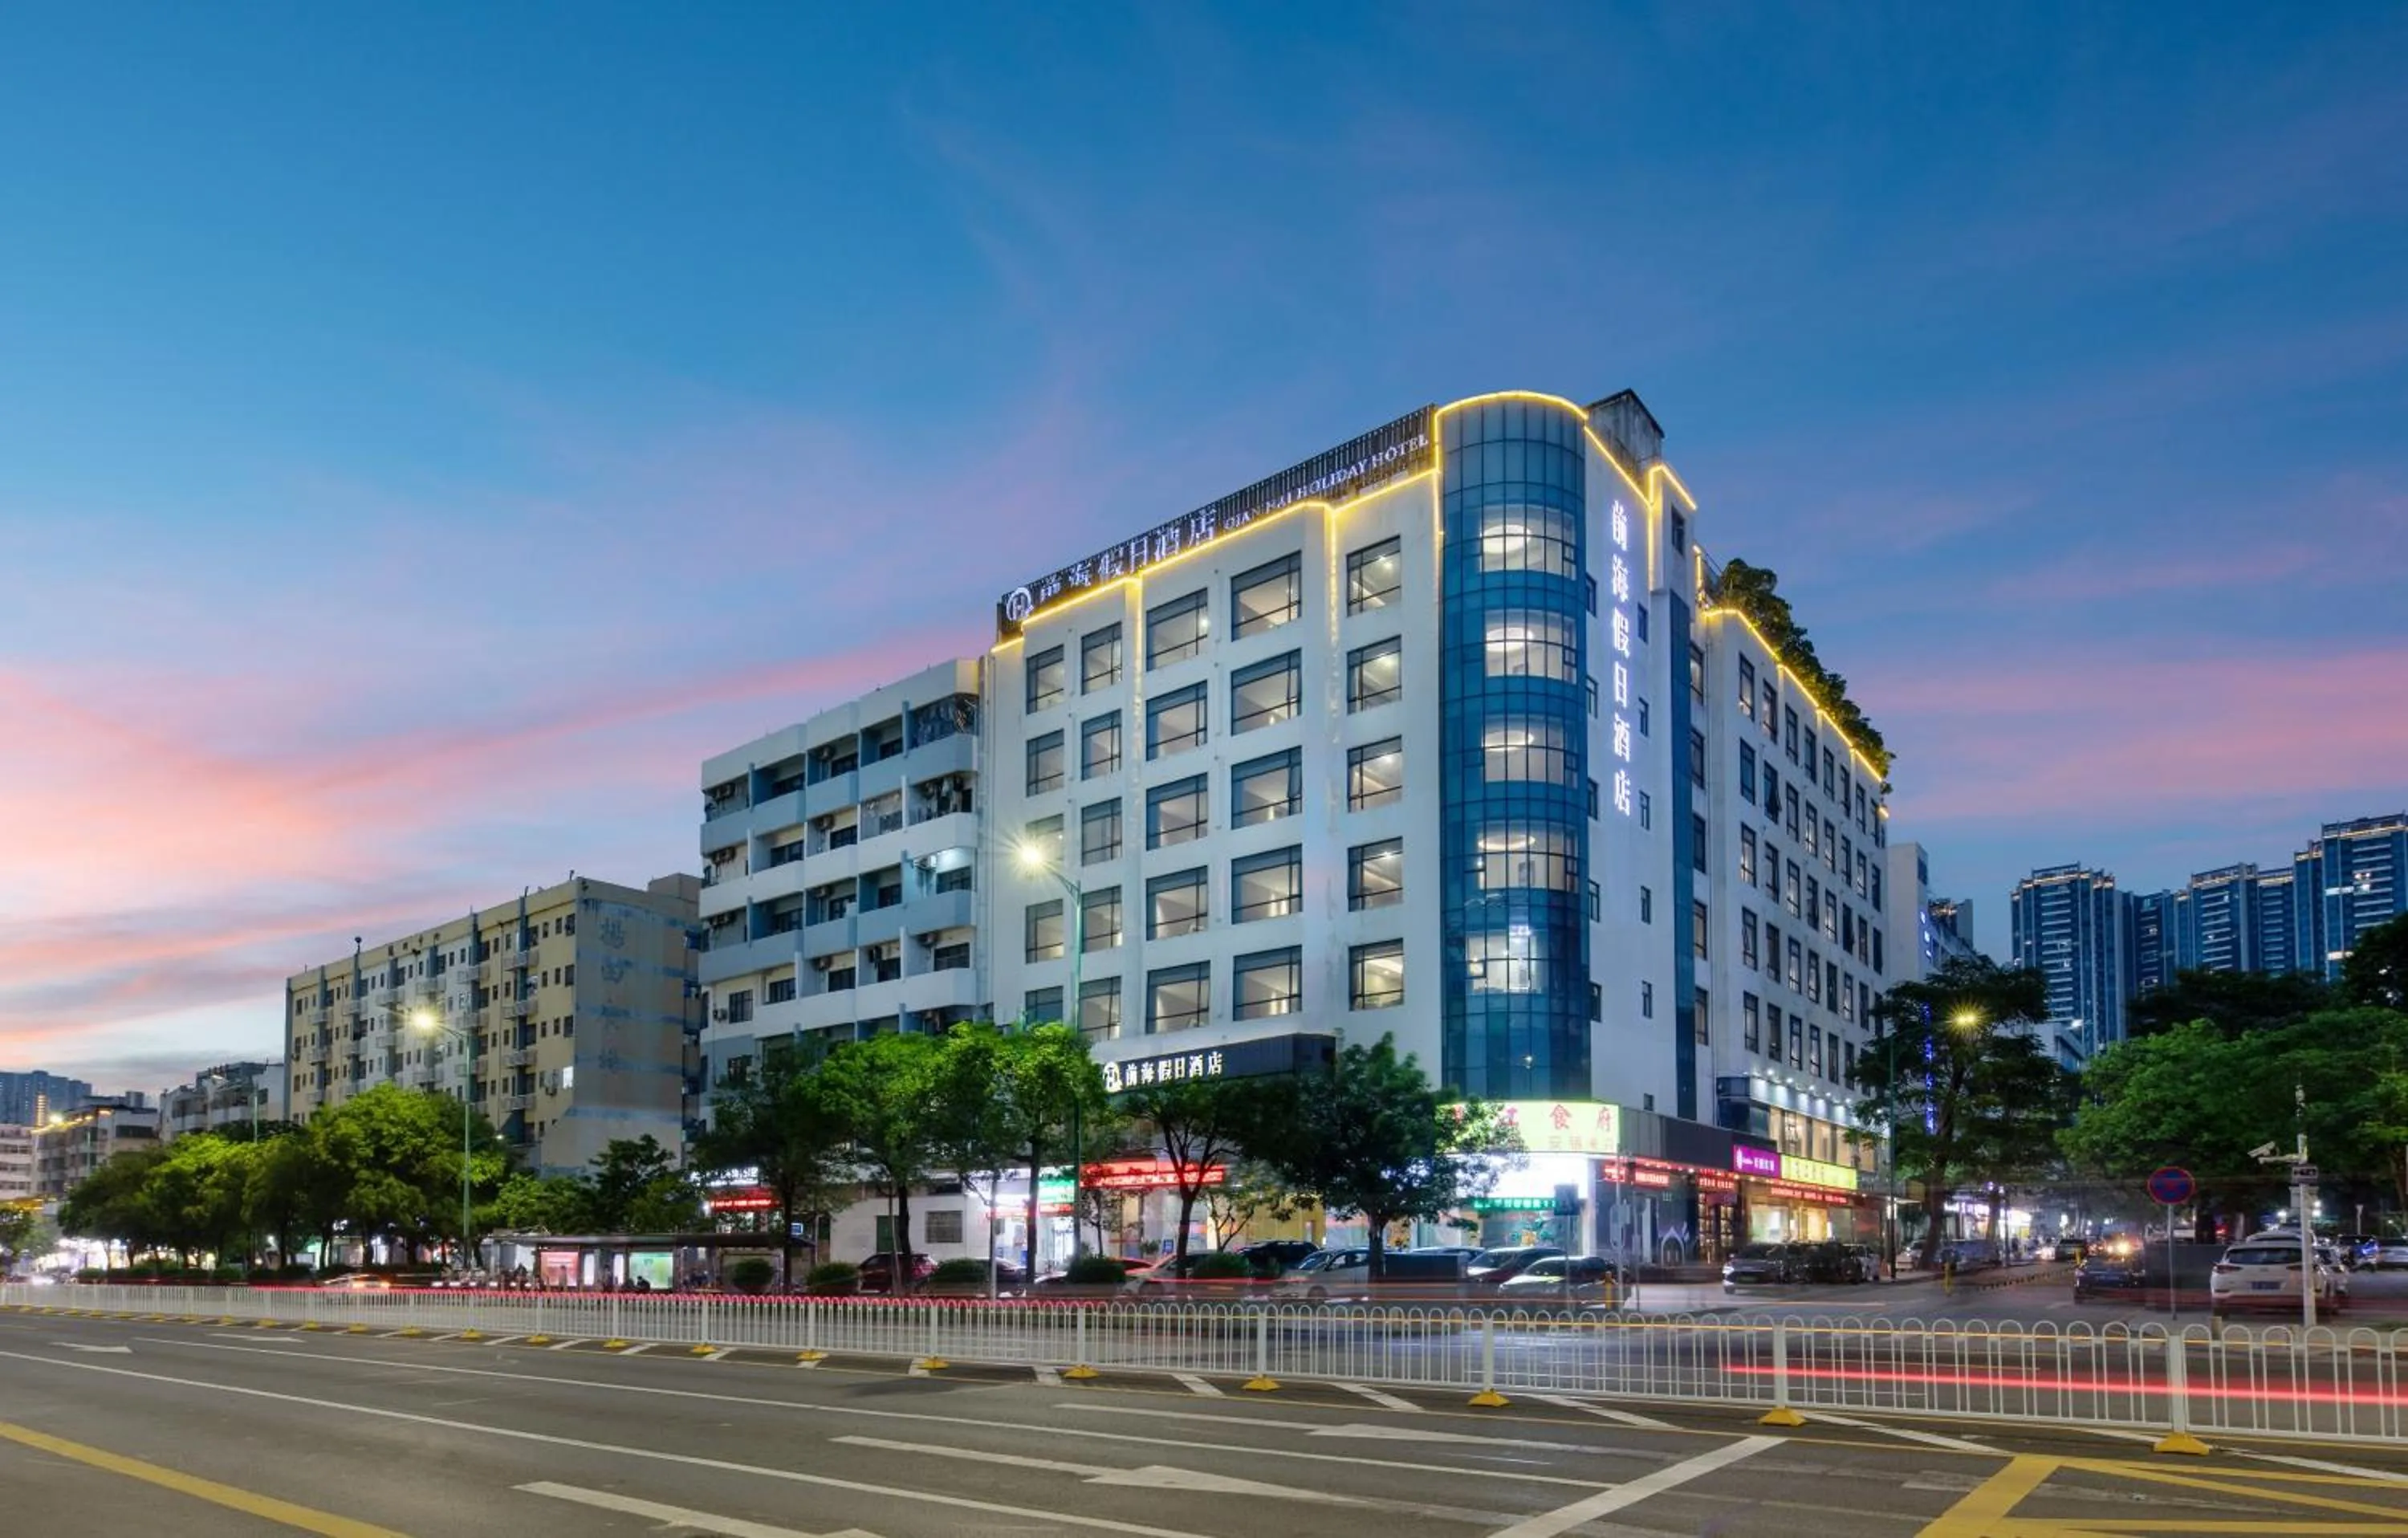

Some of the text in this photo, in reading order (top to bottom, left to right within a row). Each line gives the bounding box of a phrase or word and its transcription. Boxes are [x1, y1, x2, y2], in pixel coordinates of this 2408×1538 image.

[1296, 460, 1368, 498] HOLIDAY
[1371, 433, 1429, 468] HOTEL
[1612, 499, 1631, 817] 前海假日酒店
[1125, 1050, 1223, 1087] 前海假日酒店
